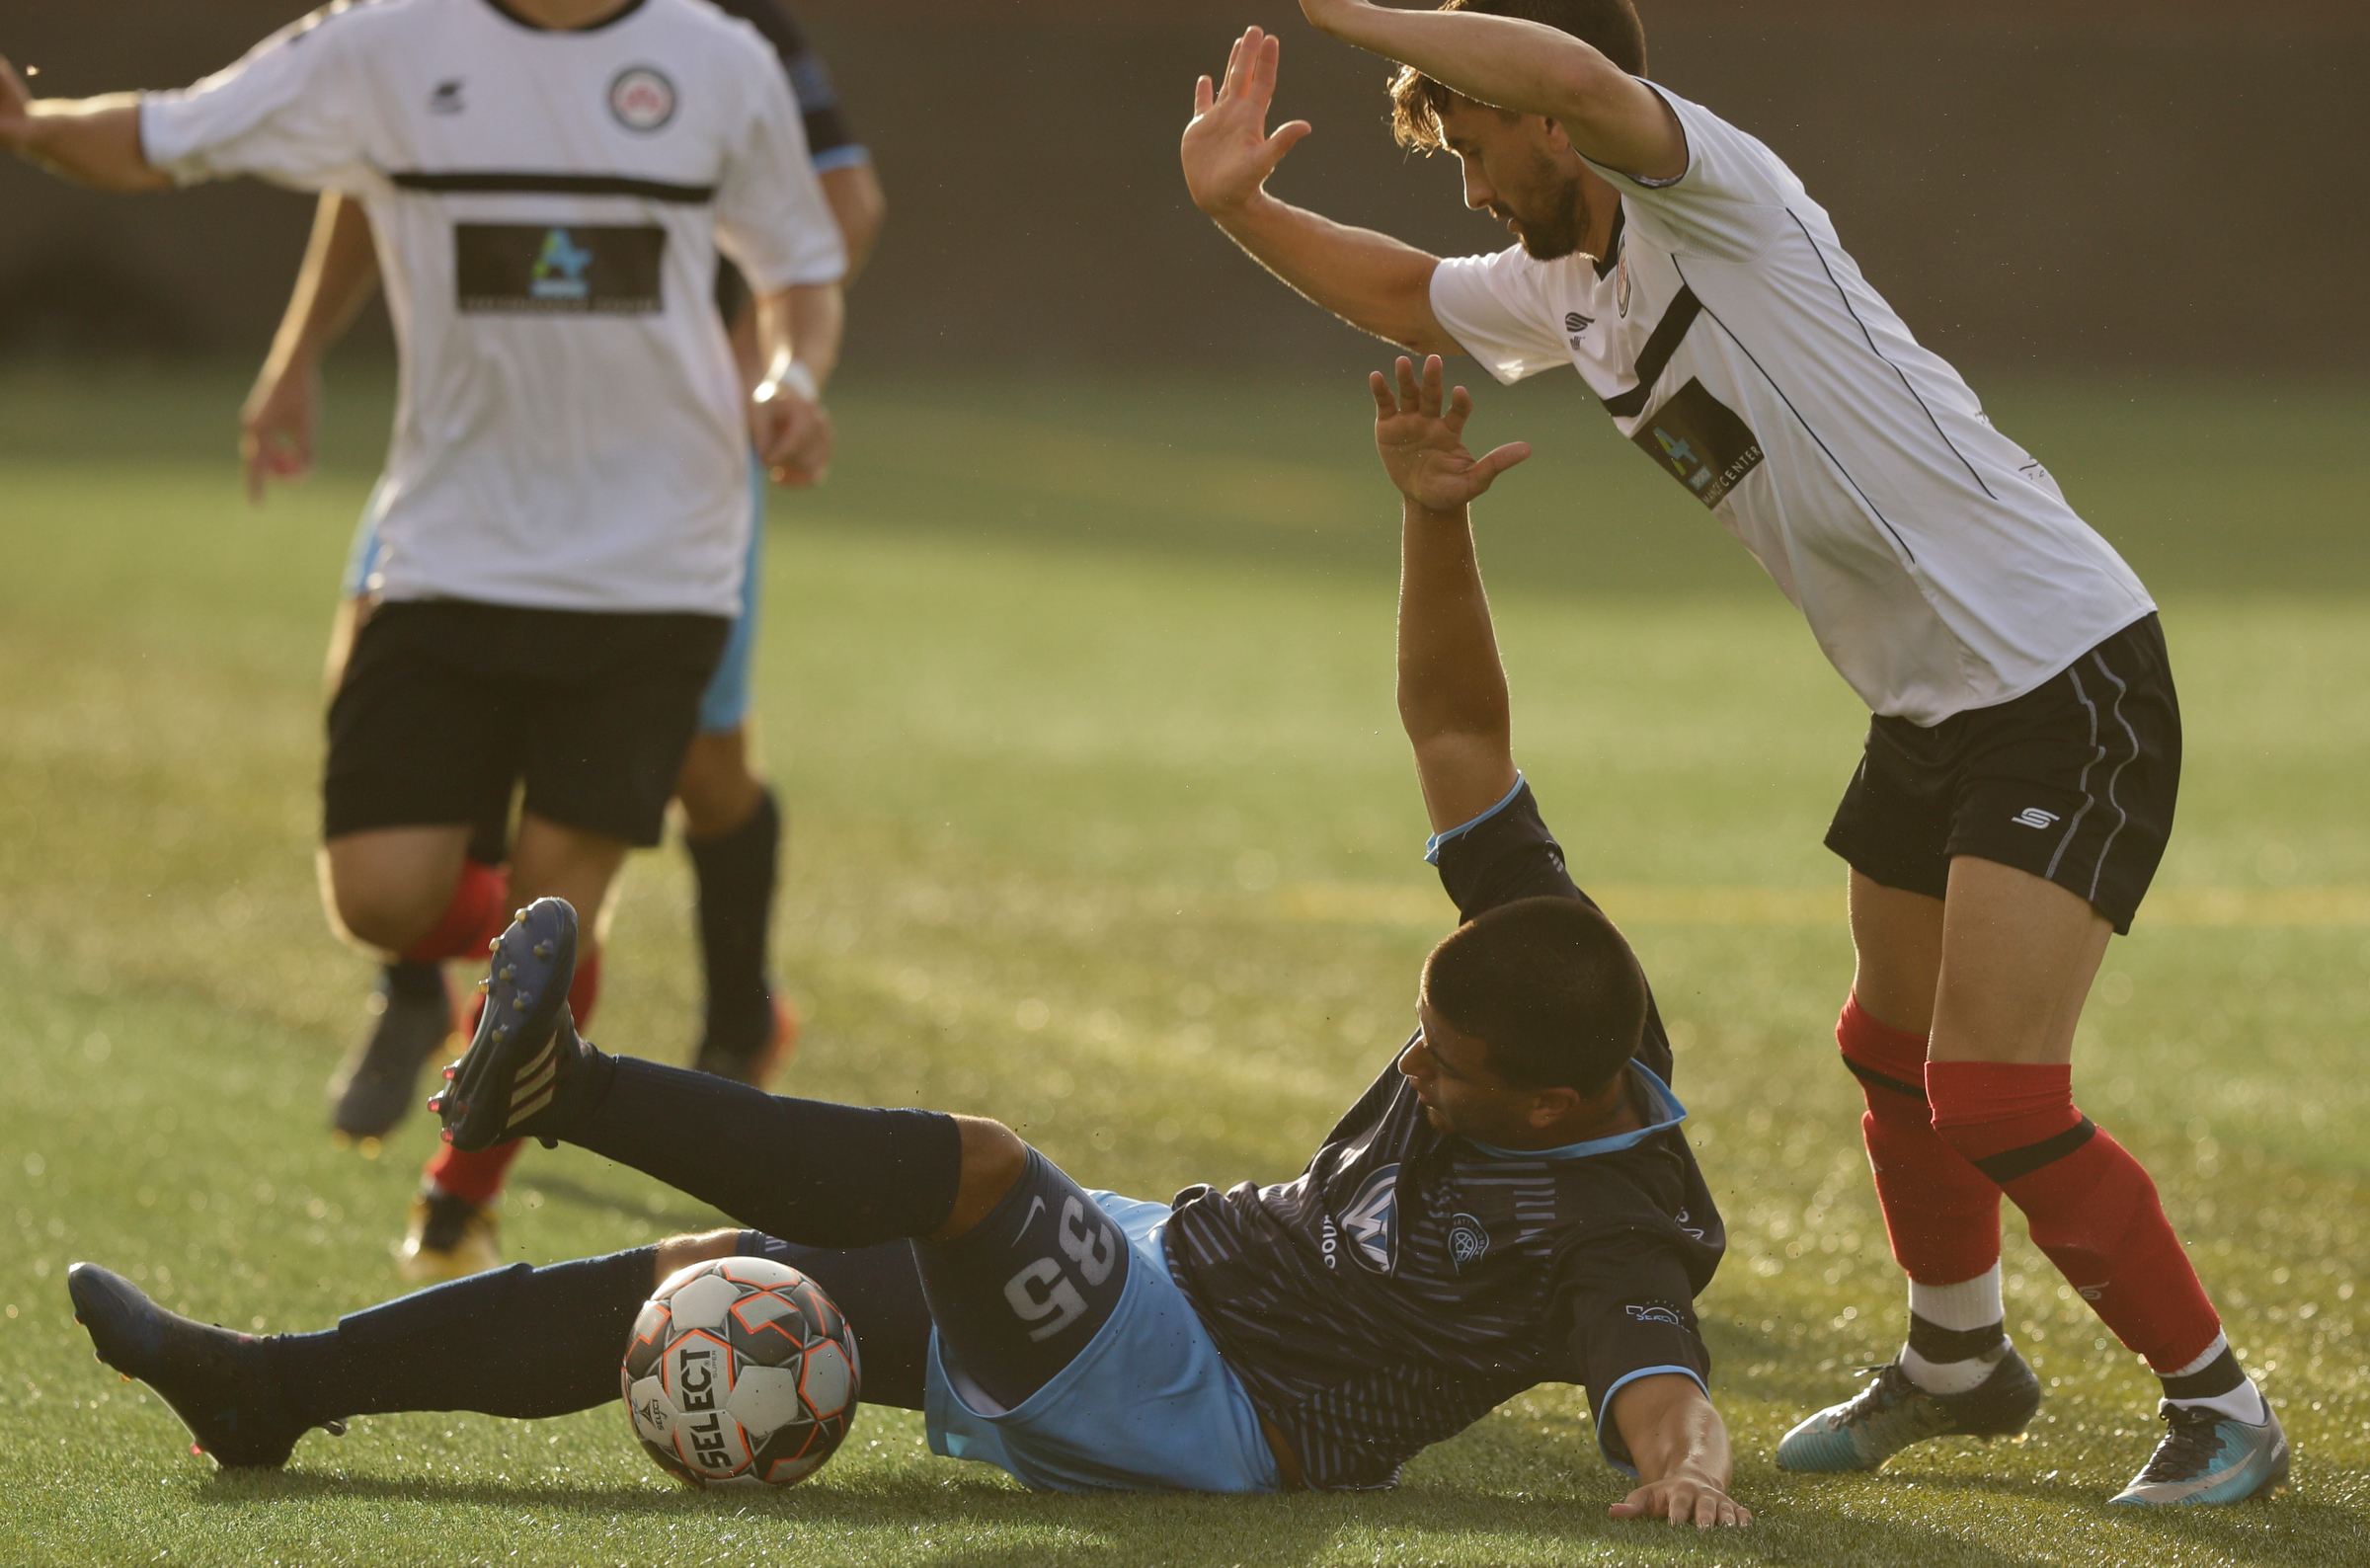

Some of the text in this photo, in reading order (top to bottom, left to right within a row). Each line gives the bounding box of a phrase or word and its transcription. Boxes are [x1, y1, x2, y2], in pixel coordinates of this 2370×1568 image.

[1719, 446, 1761, 487] CENTER
[1004, 1196, 1116, 1342] 35
[653, 1398, 667, 1431] SELECT
[680, 1349, 733, 1469] SELECT
